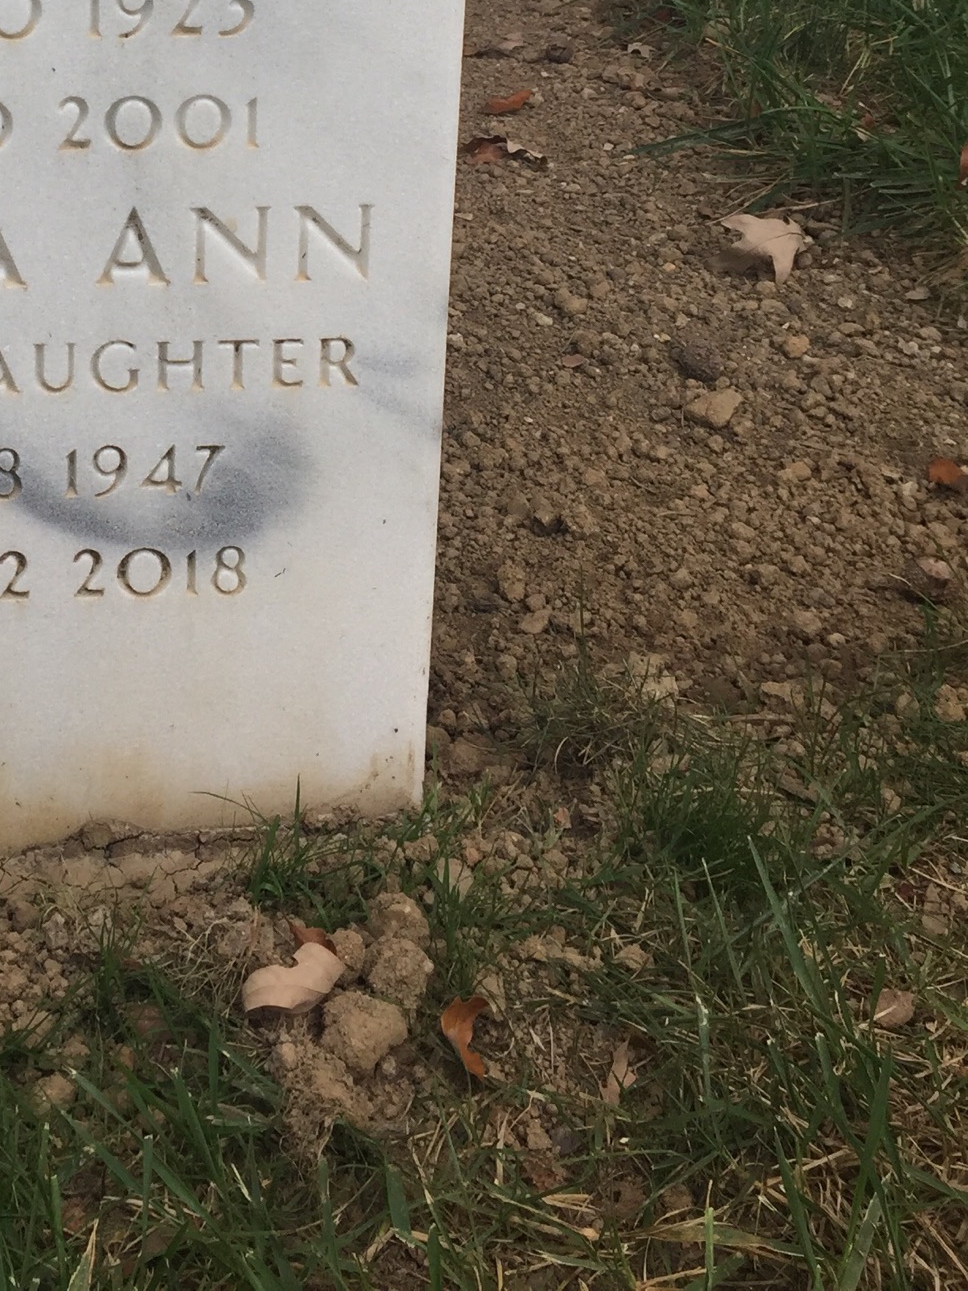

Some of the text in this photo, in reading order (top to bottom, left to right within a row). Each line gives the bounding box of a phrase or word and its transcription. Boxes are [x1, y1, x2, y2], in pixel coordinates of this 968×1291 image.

[58, 94, 261, 152] 2001
[95, 204, 374, 286] ANN
[64, 444, 226, 498] 1947
[73, 545, 248, 600] 2018
